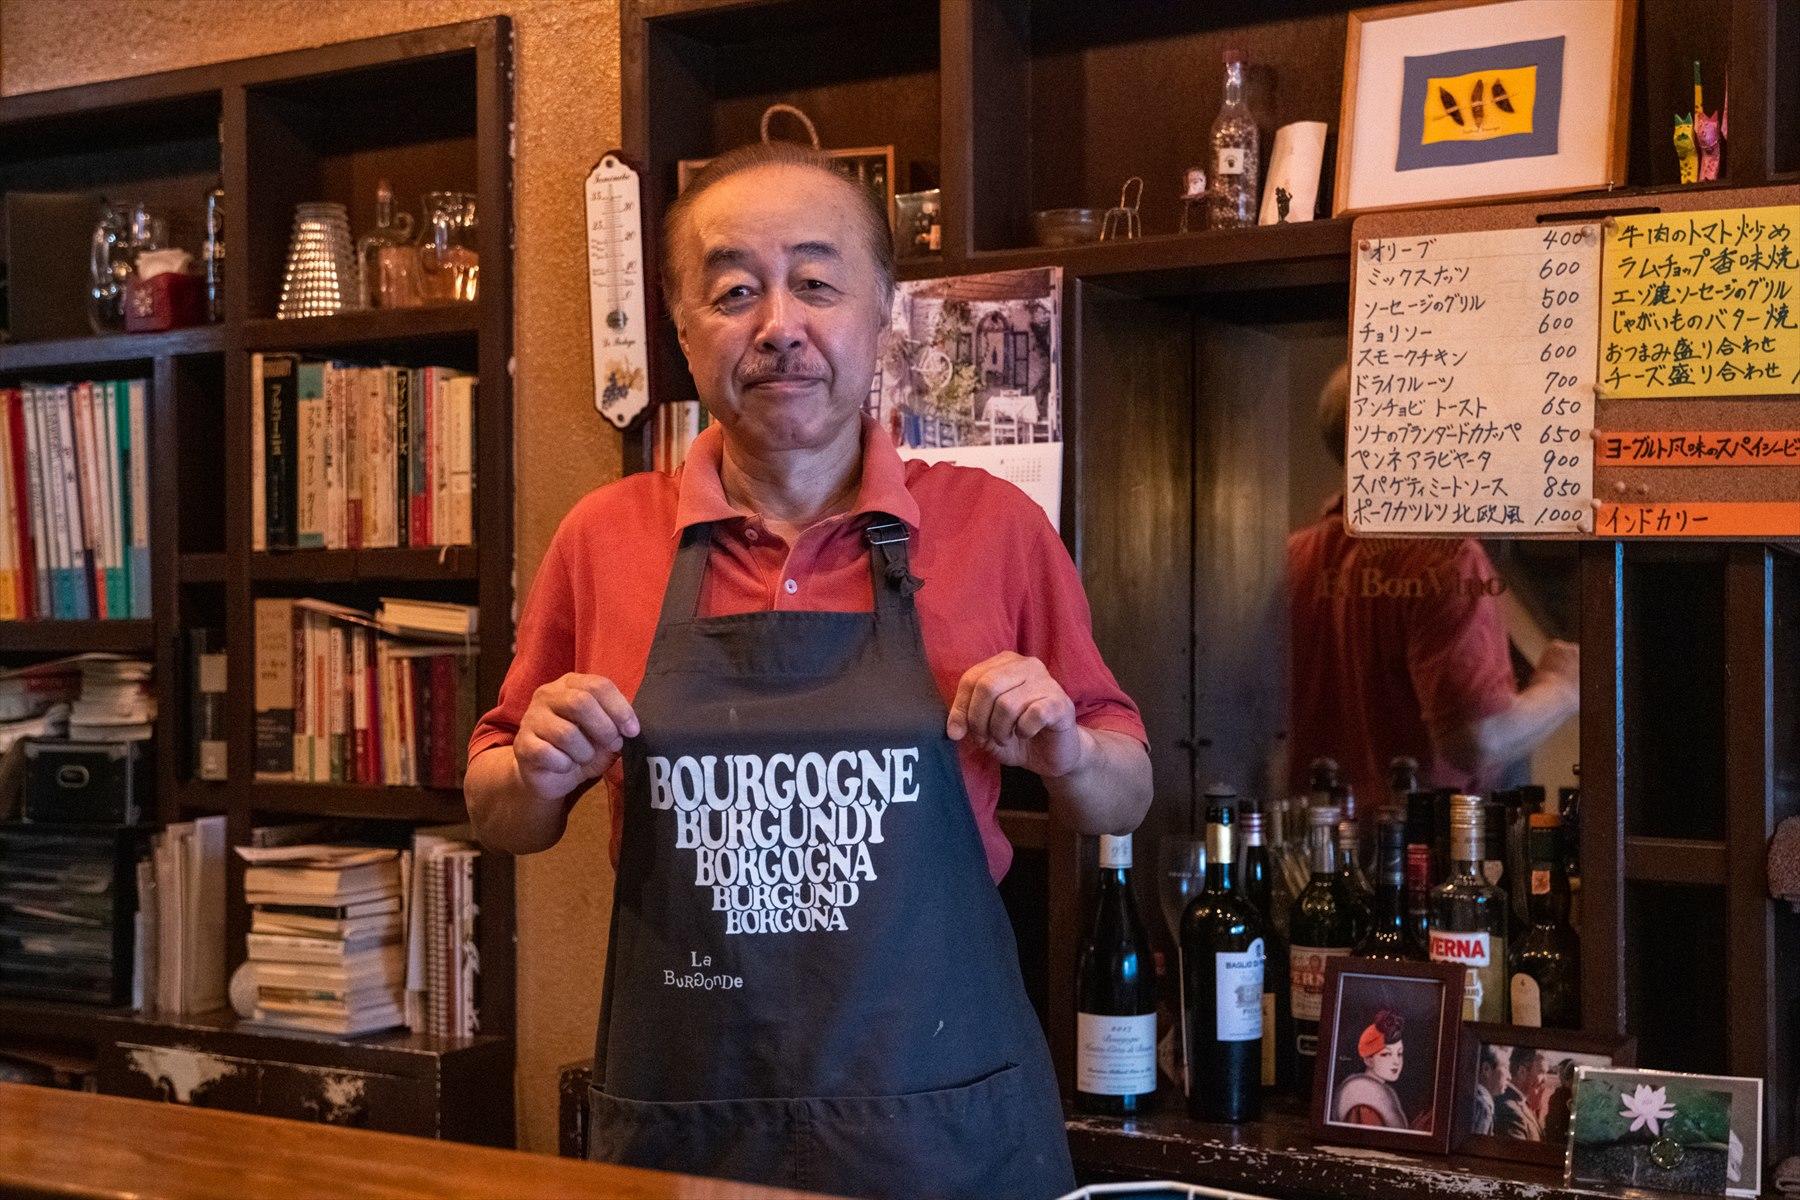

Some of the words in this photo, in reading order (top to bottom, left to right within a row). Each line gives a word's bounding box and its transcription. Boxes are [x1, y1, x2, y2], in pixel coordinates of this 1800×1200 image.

[1618, 214, 1790, 248] 牛肉のトマト炒め
[1370, 238, 1438, 263] オリーブ
[1542, 230, 1582, 250] 400
[1367, 264, 1470, 287] ミックスナッツ
[1539, 258, 1580, 280] 600
[1365, 292, 1486, 319] ソーセージのグリル
[1541, 287, 1580, 309] 500
[1612, 277, 1793, 306] エゾ鹿ソーセージのグリル
[1359, 321, 1432, 343] チョリソー
[1538, 313, 1574, 335] 600
[1612, 302, 1798, 333] じゃがいものバター焼
[1356, 348, 1468, 368] スモークチキン
[1540, 343, 1577, 362] 600
[1605, 335, 1776, 364] おつまみ盛り合わせ
[1356, 374, 1455, 396] ドライフルーツ
[1544, 371, 1578, 394] 700
[1604, 361, 1782, 390] チーズ盛り合わせ
[1540, 396, 1581, 416] 650
[1539, 424, 1581, 444] 650
[1543, 449, 1580, 474] 900
[1543, 476, 1581, 498] 850
[1605, 507, 1709, 534] インドカリー
[647, 747, 920, 811] BOURGOGNE
[674, 799, 889, 850] BURGUNDY
[695, 841, 878, 886] BORGOGNA
[711, 881, 860, 911] BURGUND
[725, 905, 849, 935] BORGONA
[690, 951, 712, 967] La
